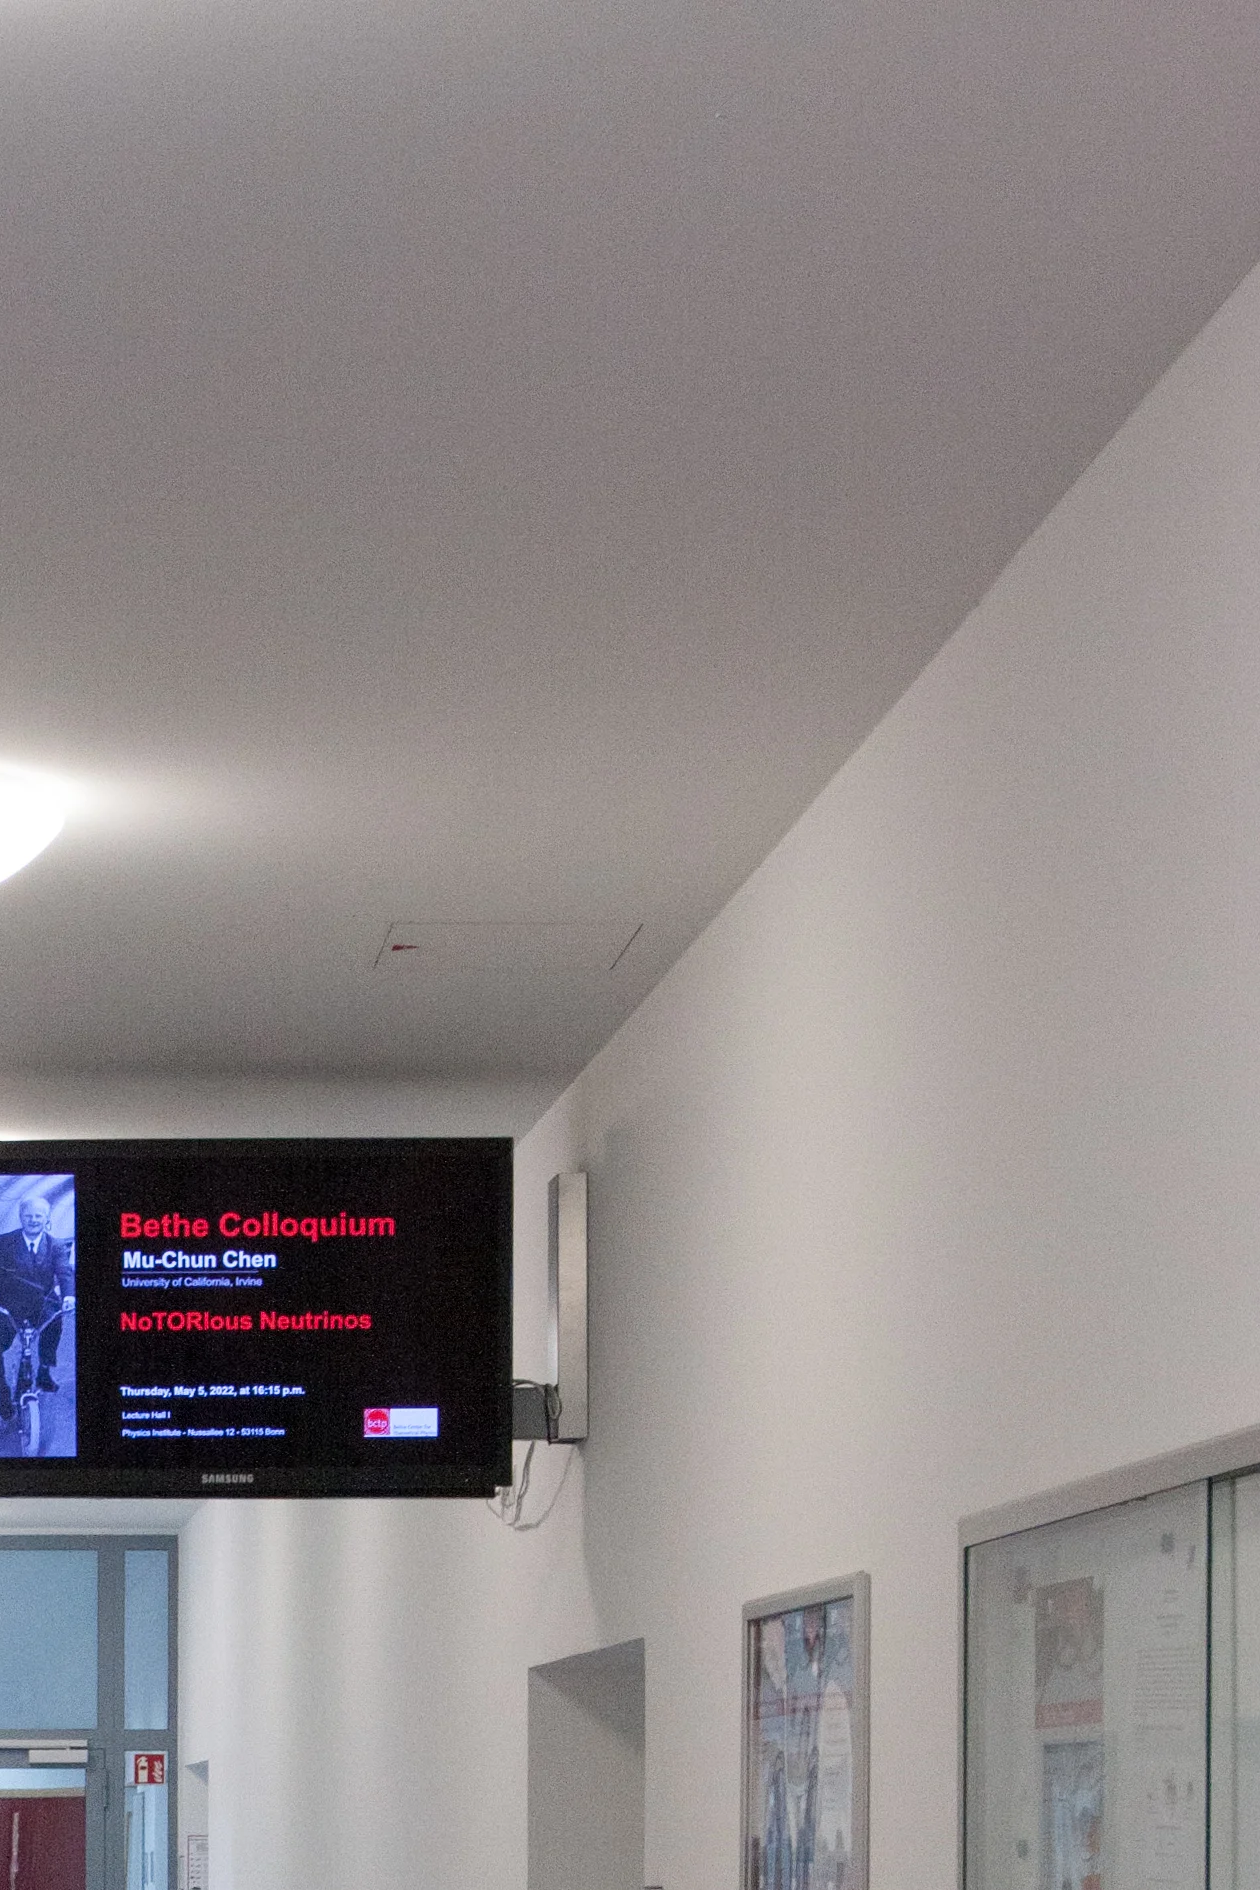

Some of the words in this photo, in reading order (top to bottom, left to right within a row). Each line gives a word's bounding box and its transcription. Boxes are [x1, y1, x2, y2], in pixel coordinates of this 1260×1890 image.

[120, 1212, 209, 1238] Bethe
[219, 1211, 396, 1243] Colloquium
[123, 1250, 217, 1269] Mu-Chun
[223, 1250, 277, 1268] Chen
[121, 1277, 170, 1289] University
[172, 1277, 183, 1287] of
[184, 1276, 234, 1288] California,
[235, 1276, 263, 1287] Irvine
[259, 1310, 373, 1331] Neutrinos
[120, 1386, 172, 1398] Thursday,
[174, 1386, 196, 1398] May
[198, 1386, 208, 1397] 5,
[209, 1386, 238, 1397] 2022,
[240, 1386, 251, 1396] at
[252, 1385, 281, 1396] 16:15
[282, 1386, 306, 1397] p.m.
[122, 1411, 150, 1420] Lecture
[151, 1411, 167, 1419] Hall
[122, 1429, 151, 1439] Physics
[225, 1428, 236, 1437] 12
[265, 1428, 286, 1436] Bonn
[201, 1473, 255, 1484] SAMSUNG
